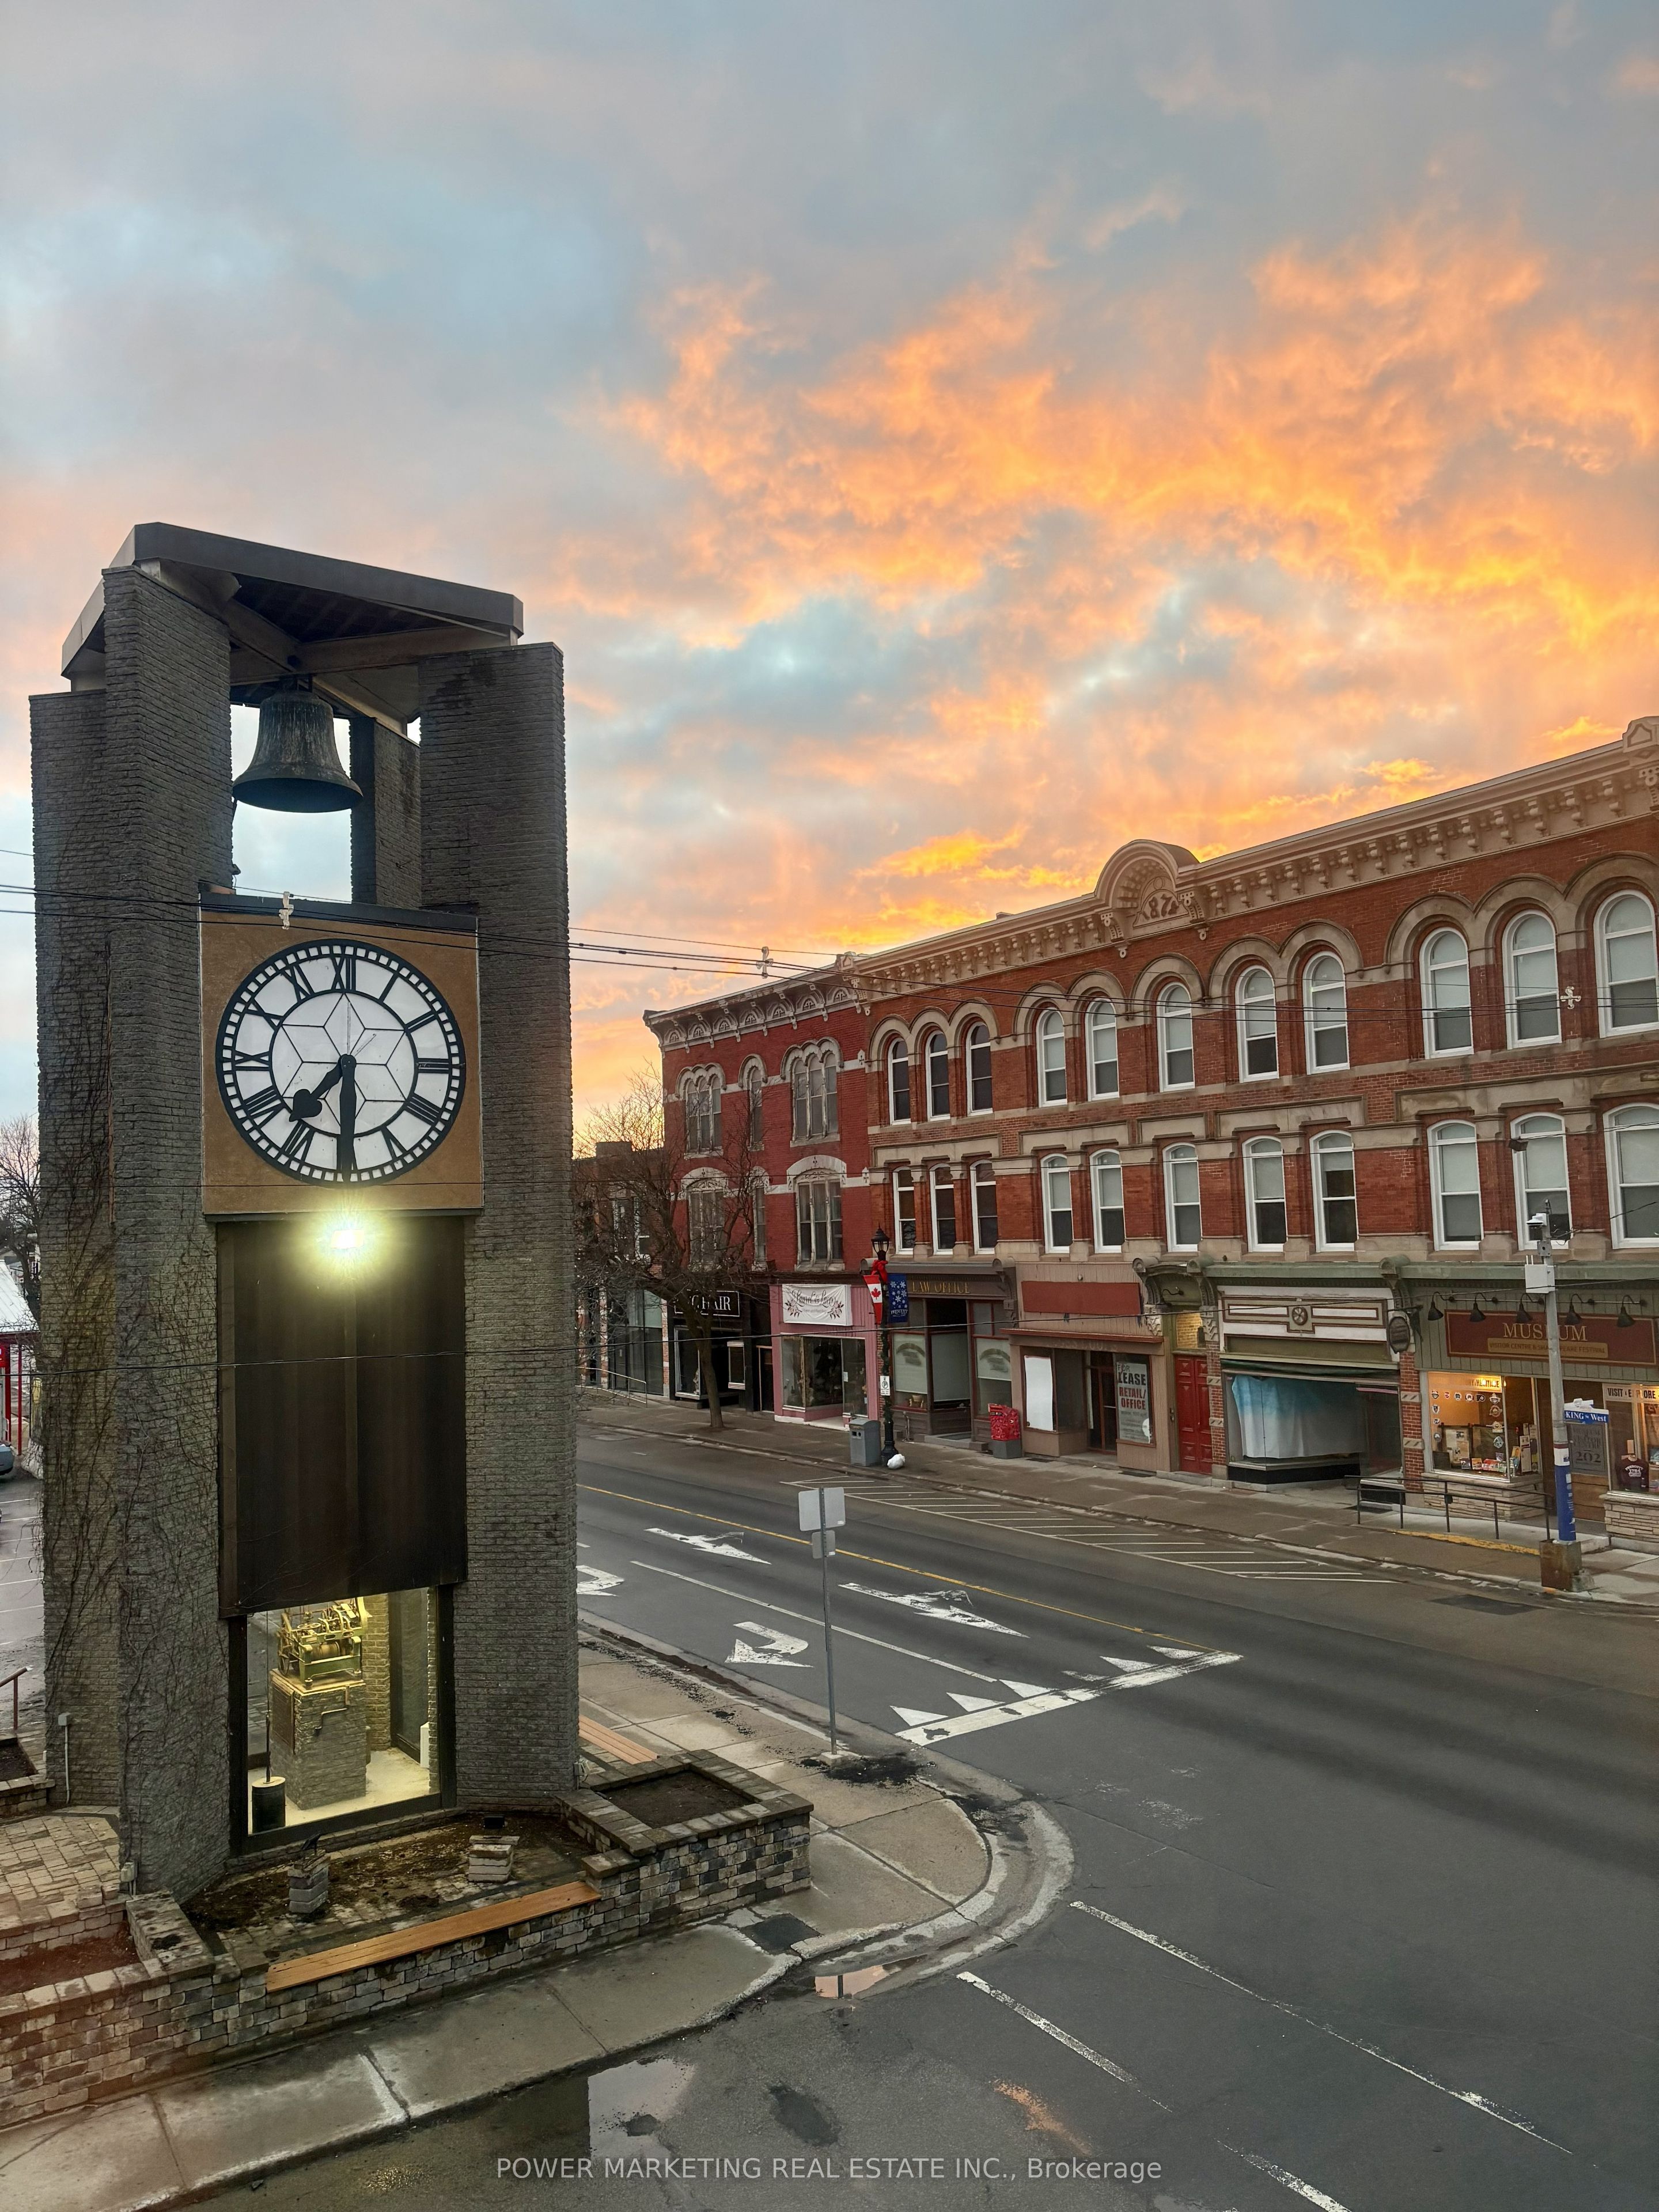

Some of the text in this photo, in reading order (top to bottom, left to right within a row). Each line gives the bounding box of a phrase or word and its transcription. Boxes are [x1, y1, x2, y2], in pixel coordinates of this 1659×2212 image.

[331, 957, 356, 990] XII
[912, 1281, 970, 1294] LAW OFFICE
[1502, 1323, 1588, 1341] MUSUM
[1118, 1364, 1130, 1372] FOR
[1118, 1372, 1146, 1386] LEASE
[1608, 1388, 1656, 1399] VISIT EPORE
[1121, 1398, 1146, 1410] OFFICE
[1566, 1411, 1584, 1419] KING
[1590, 1413, 1607, 1422] West
[1576, 1452, 1601, 1463] 202
